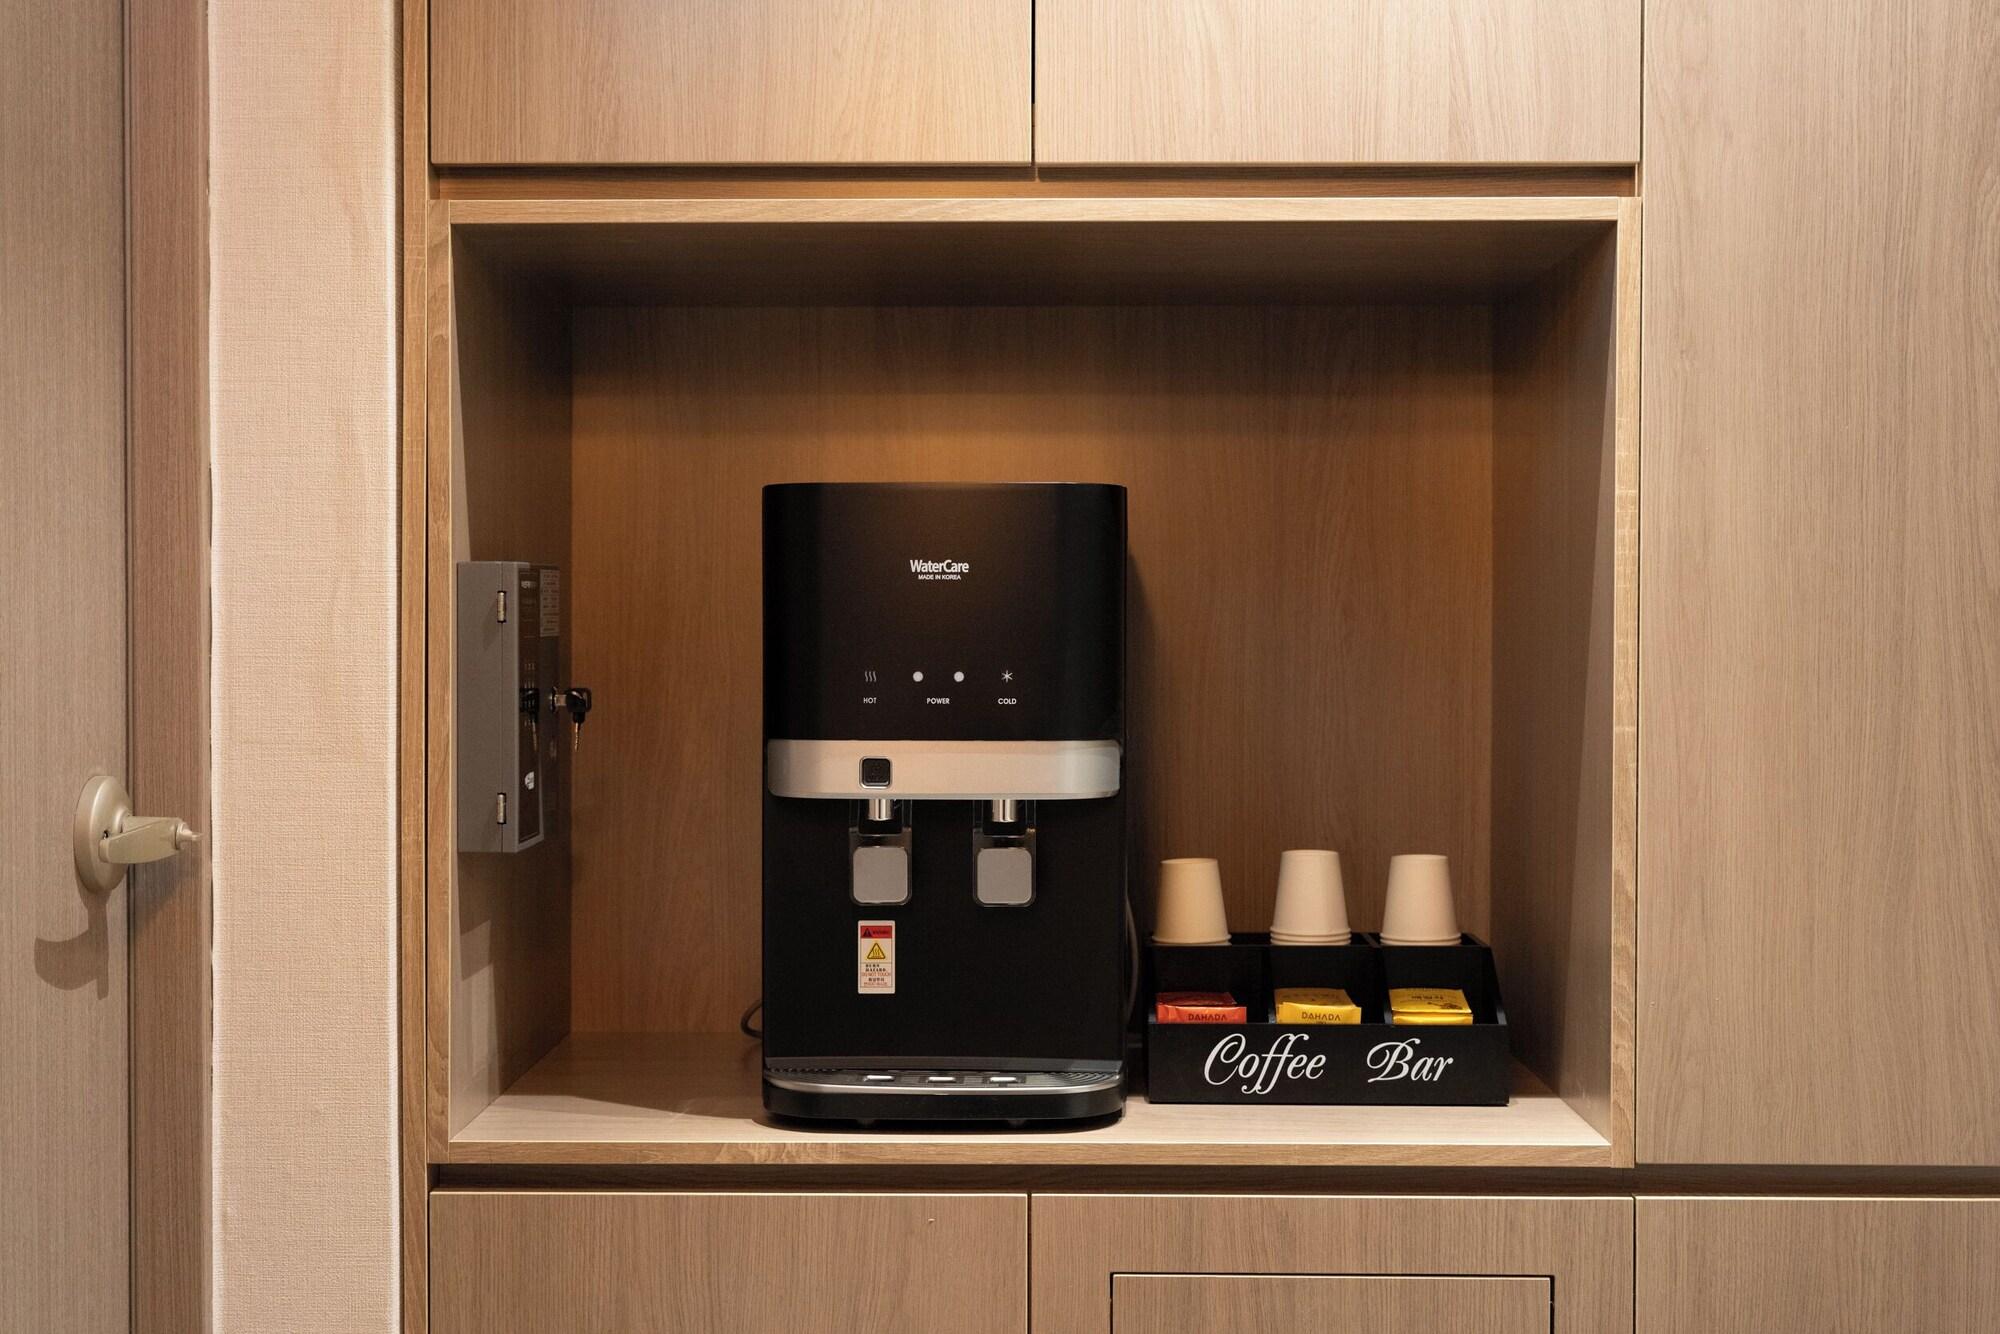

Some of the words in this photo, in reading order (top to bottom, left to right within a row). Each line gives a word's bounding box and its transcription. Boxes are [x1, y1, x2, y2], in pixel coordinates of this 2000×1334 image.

[909, 559, 970, 573] WaterCare
[926, 697, 950, 705] POWER
[1301, 1011, 1341, 1021] DAHADA
[1204, 1033, 1327, 1095] Coffee
[1366, 1038, 1454, 1083] Bar
